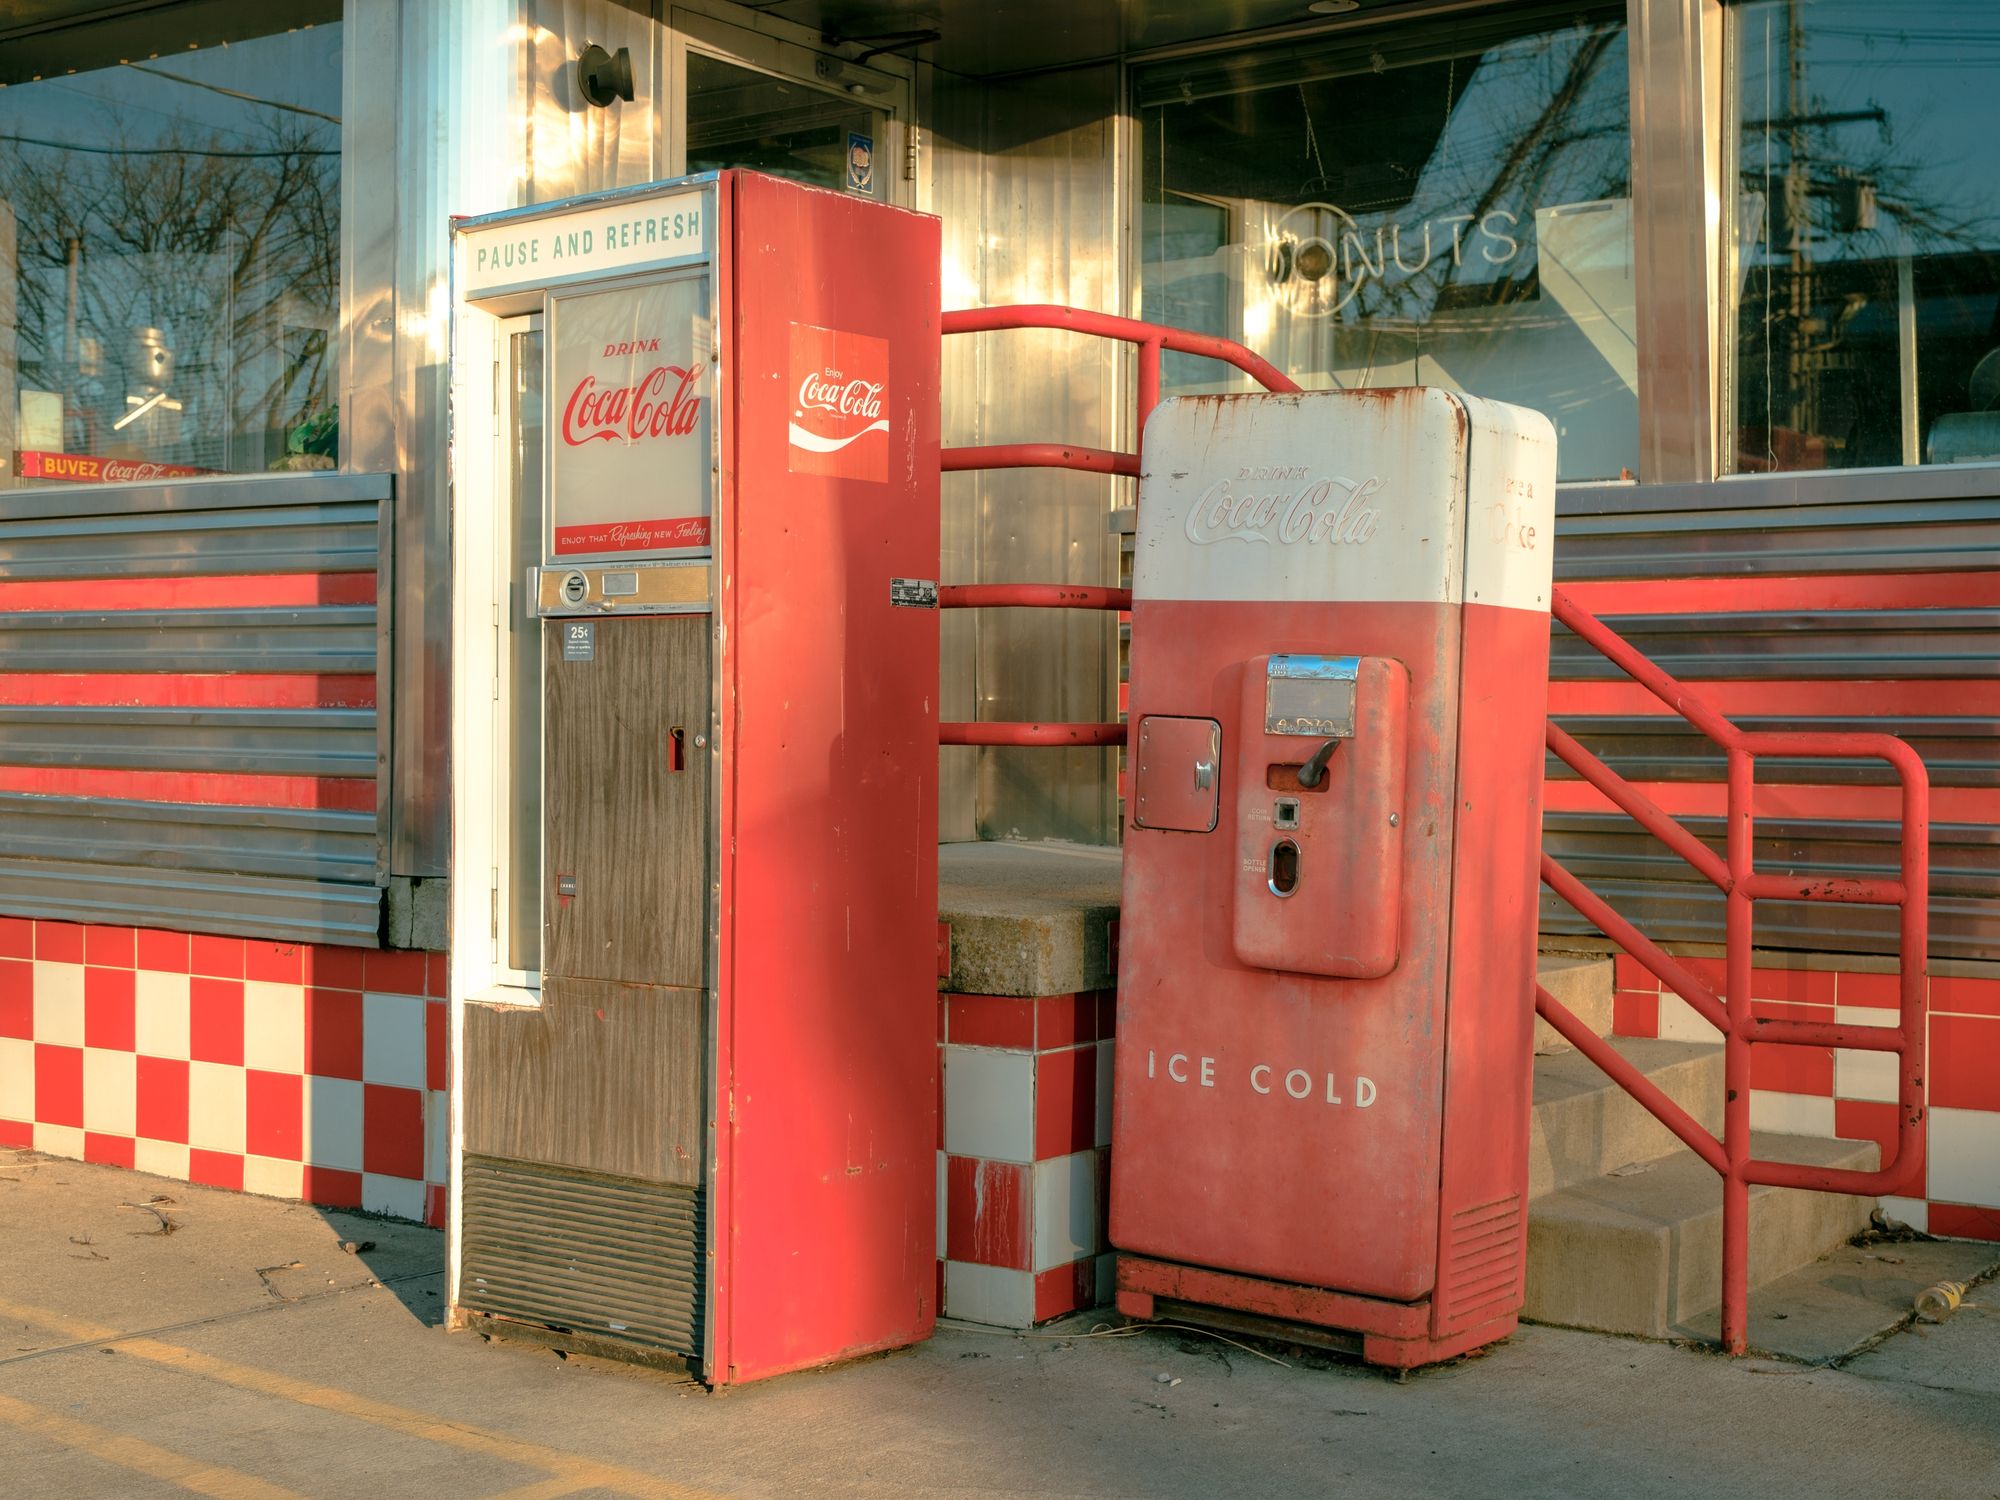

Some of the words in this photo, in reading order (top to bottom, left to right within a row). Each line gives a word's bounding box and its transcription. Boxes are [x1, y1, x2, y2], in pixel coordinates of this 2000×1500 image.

[477, 239, 539, 272] PAUSE
[553, 230, 593, 260] AND
[606, 211, 699, 250] REFRESH
[603, 338, 661, 358] DRINK
[825, 367, 843, 380] Enjoy
[562, 363, 707, 446] Coca-Cola
[799, 372, 885, 418] Coca-Cola
[44, 457, 99, 477] BUVEZ
[102, 459, 167, 482] Coca-Col
[1236, 464, 1312, 480] DRINK
[1184, 476, 1391, 545] Coca-Cola
[562, 536, 586, 545] ENJOY
[589, 534, 608, 543] THAT
[609, 525, 652, 547] Refreshing
[654, 530, 672, 539] NEW
[674, 521, 707, 544] Feeling
[571, 626, 588, 639] 25¢
[1243, 858, 1266, 866] BOTTLE
[1147, 1049, 1215, 1088] ICE
[1250, 1064, 1377, 1108] COLD
